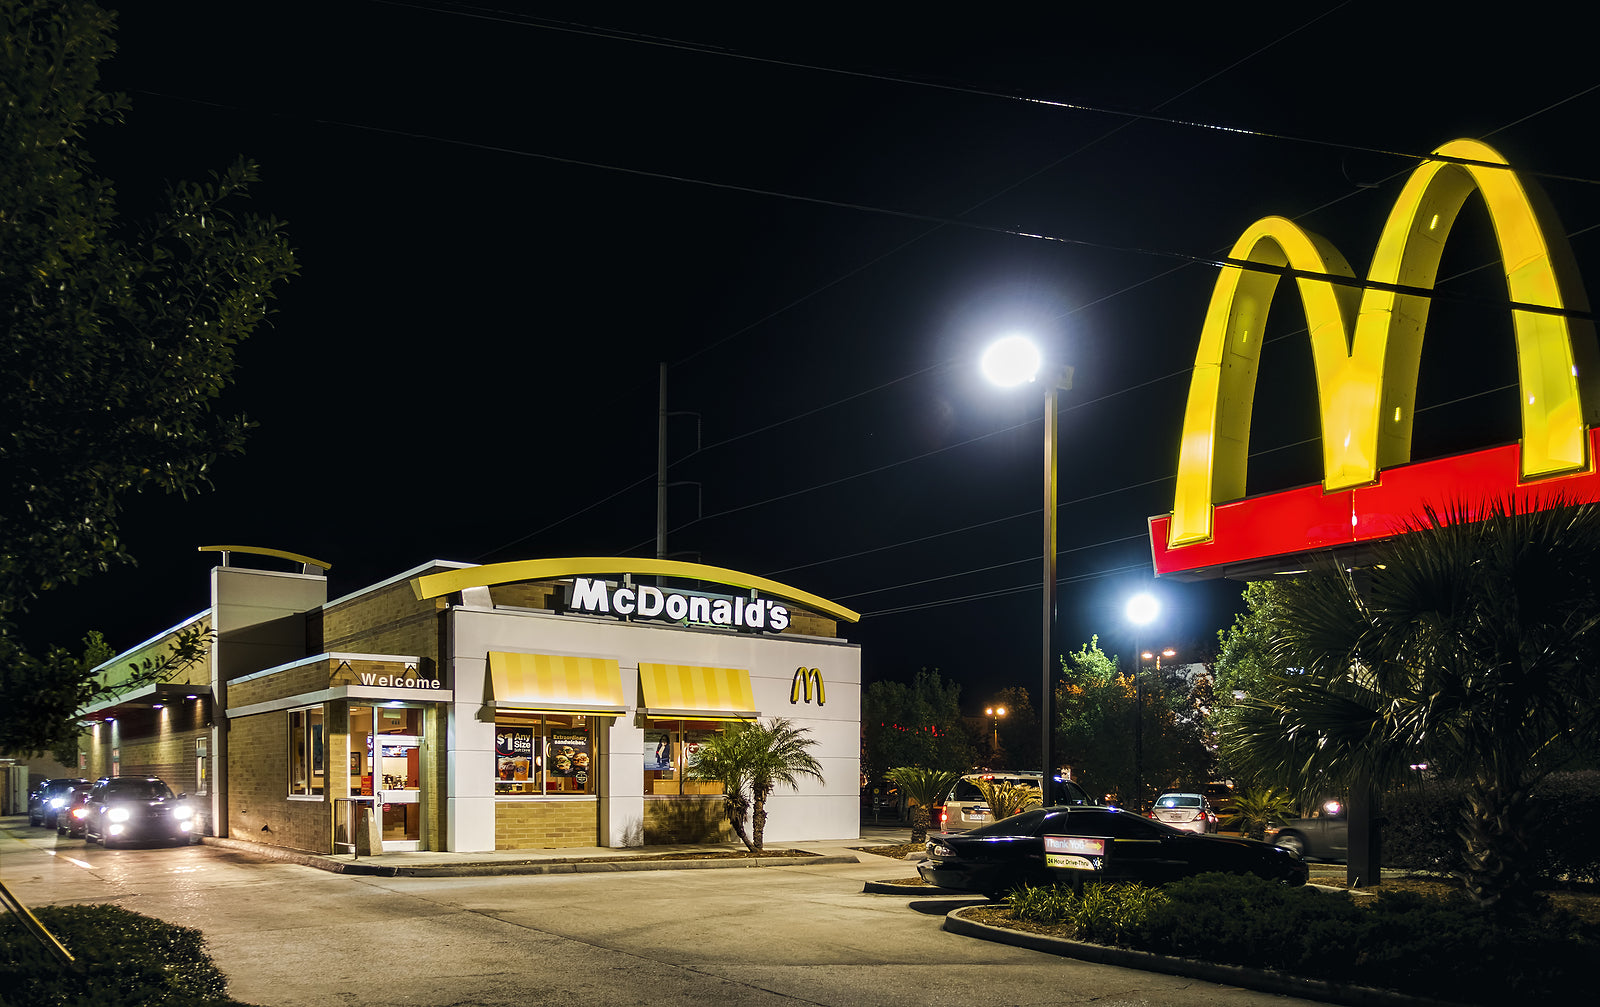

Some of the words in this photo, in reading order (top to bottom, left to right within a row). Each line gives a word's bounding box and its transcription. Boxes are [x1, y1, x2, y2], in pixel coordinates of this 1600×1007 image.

[570, 577, 789, 630] McDonald's
[361, 673, 441, 689] Welcome
[497, 733, 513, 750] $1
[514, 732, 531, 742] Any
[1046, 838, 1068, 848] Thank
[1069, 840, 1085, 849] You
